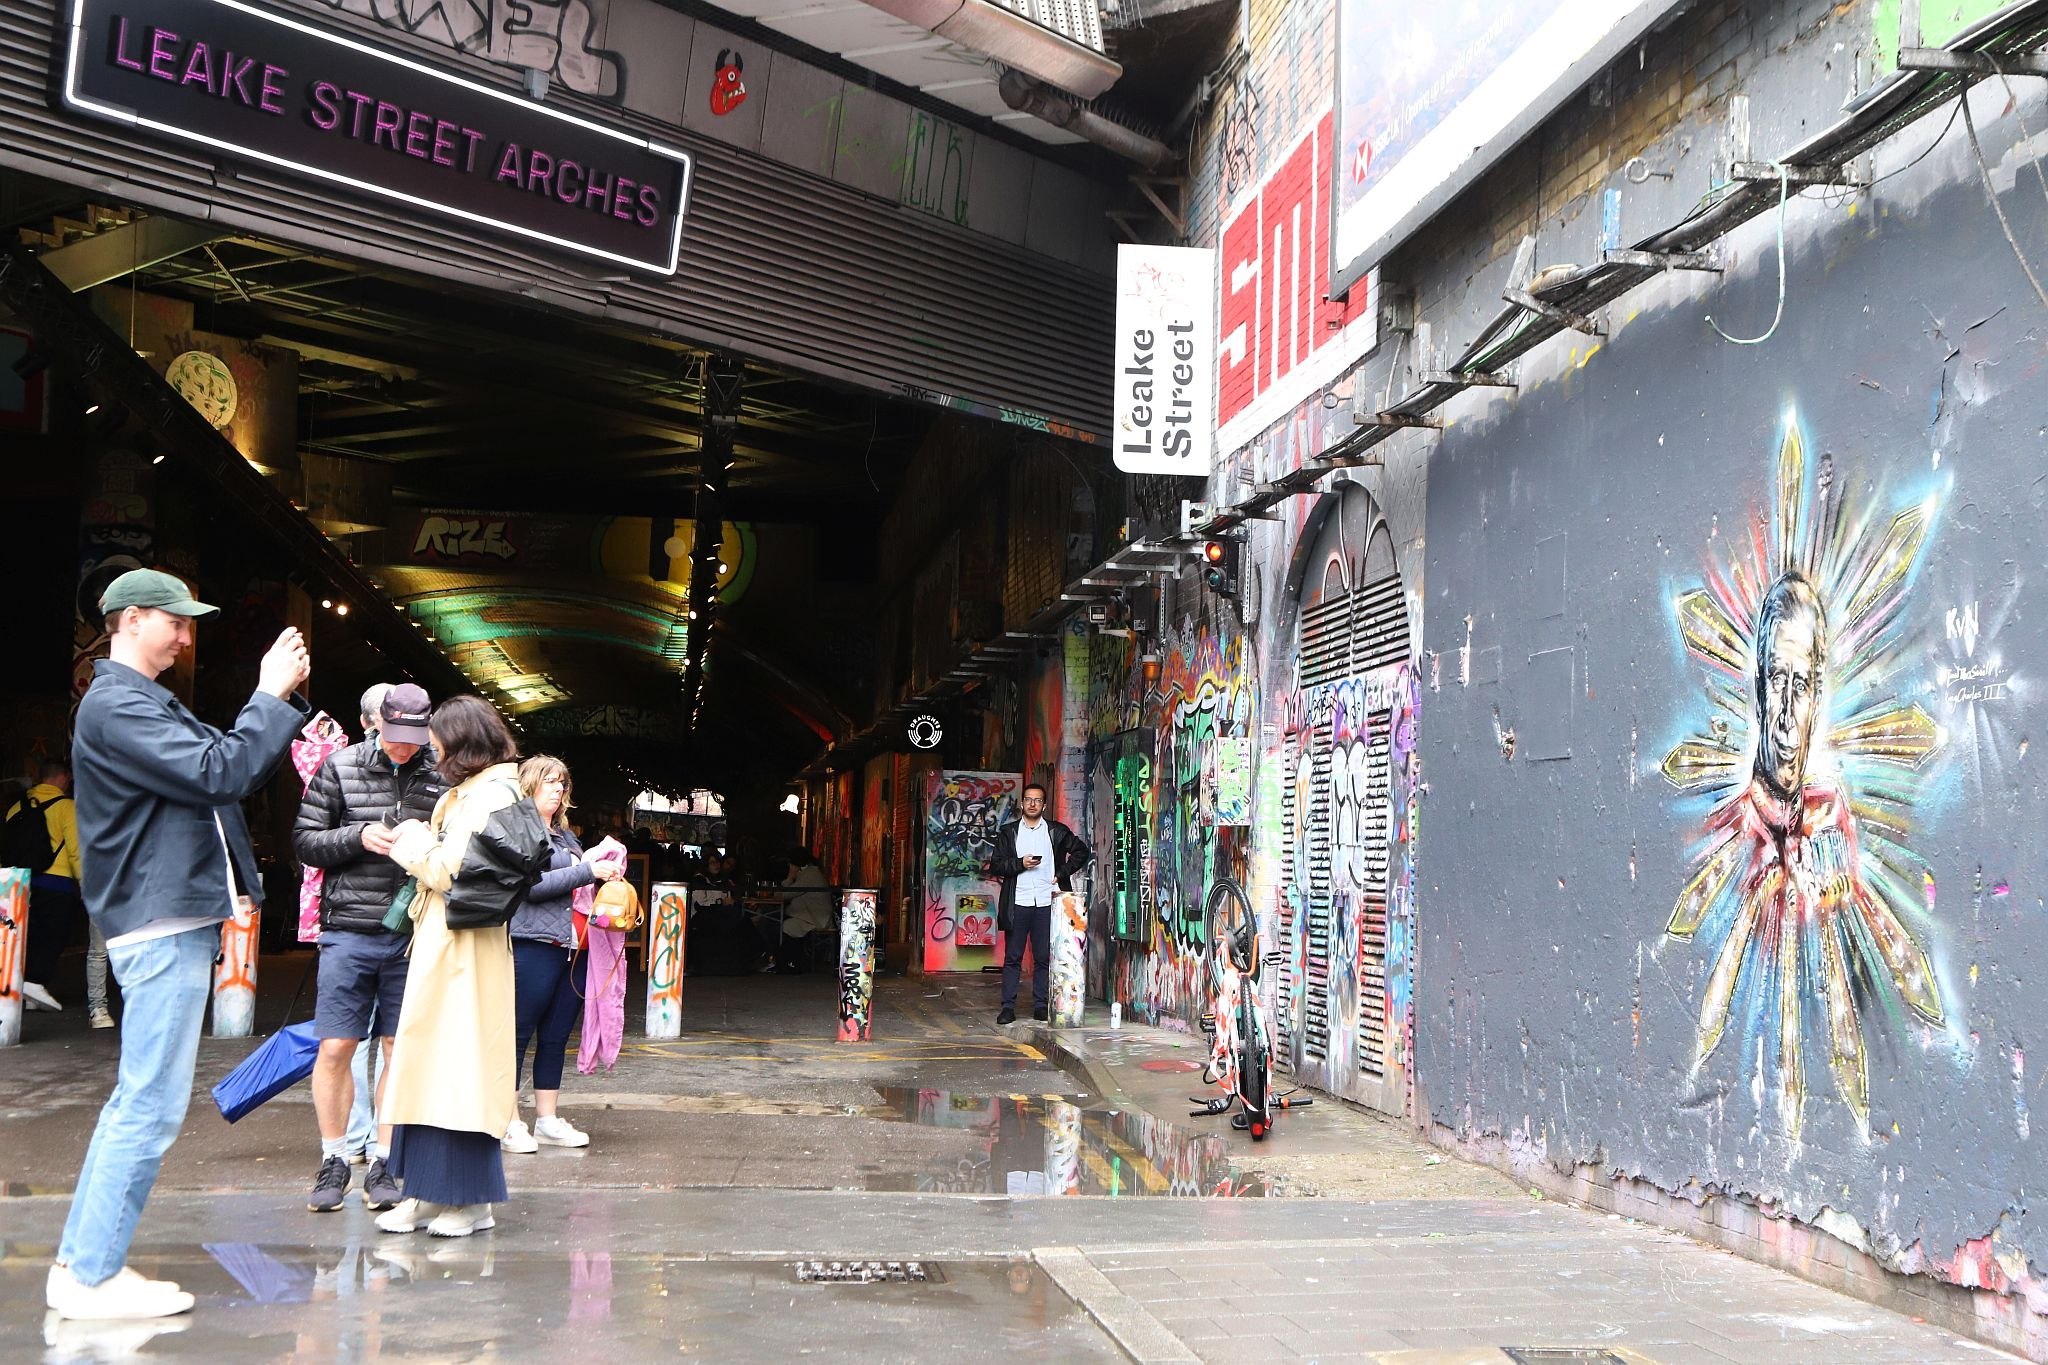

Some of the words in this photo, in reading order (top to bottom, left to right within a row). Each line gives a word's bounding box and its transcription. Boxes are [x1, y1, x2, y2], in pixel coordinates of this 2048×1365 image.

[116, 16, 288, 115] LEAKE
[311, 81, 485, 173] STREET
[496, 143, 660, 227] ARCHES
[1122, 329, 1154, 453] Leake
[1163, 319, 1194, 458] Street
